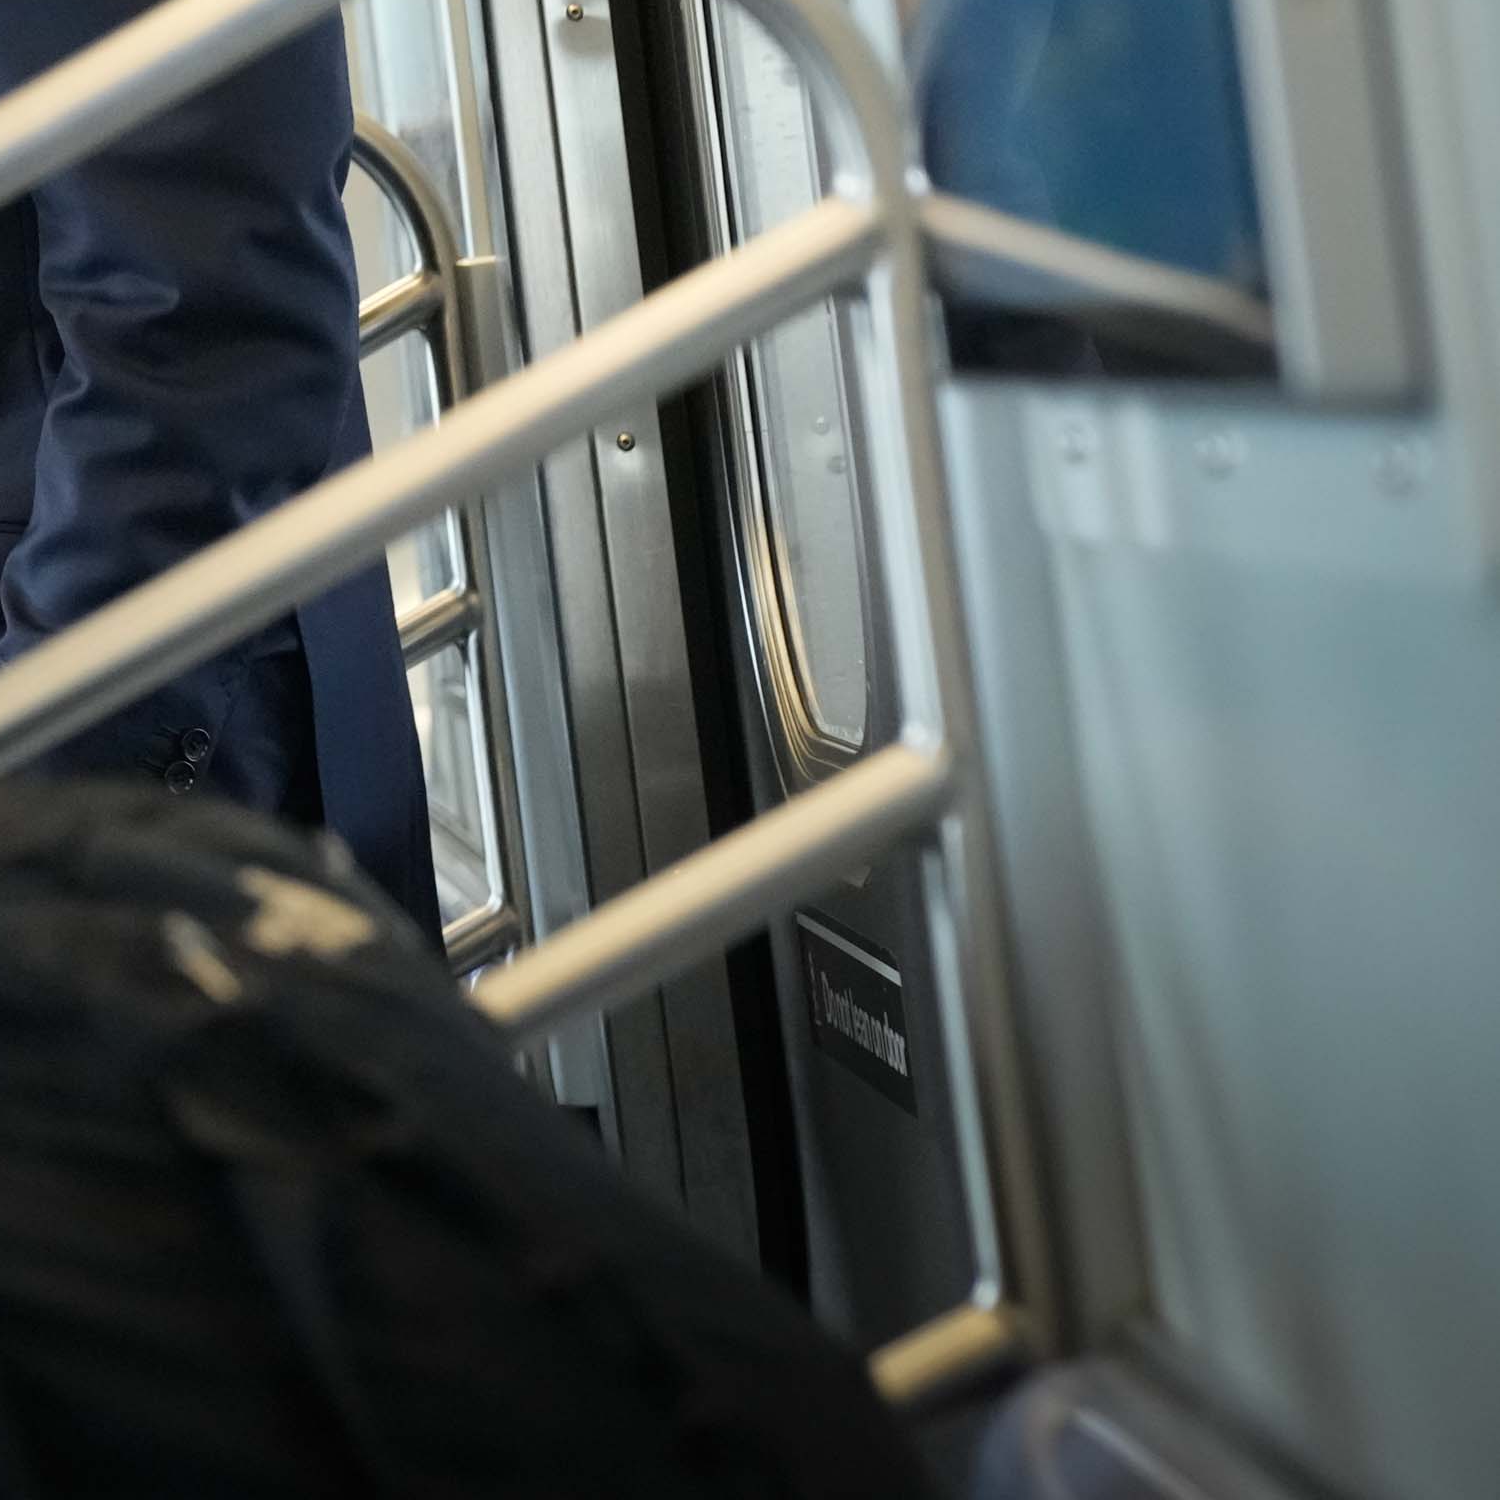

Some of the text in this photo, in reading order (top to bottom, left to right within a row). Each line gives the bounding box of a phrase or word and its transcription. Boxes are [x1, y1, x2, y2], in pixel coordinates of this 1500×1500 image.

[821, 971, 908, 1078] Do not lean on door
